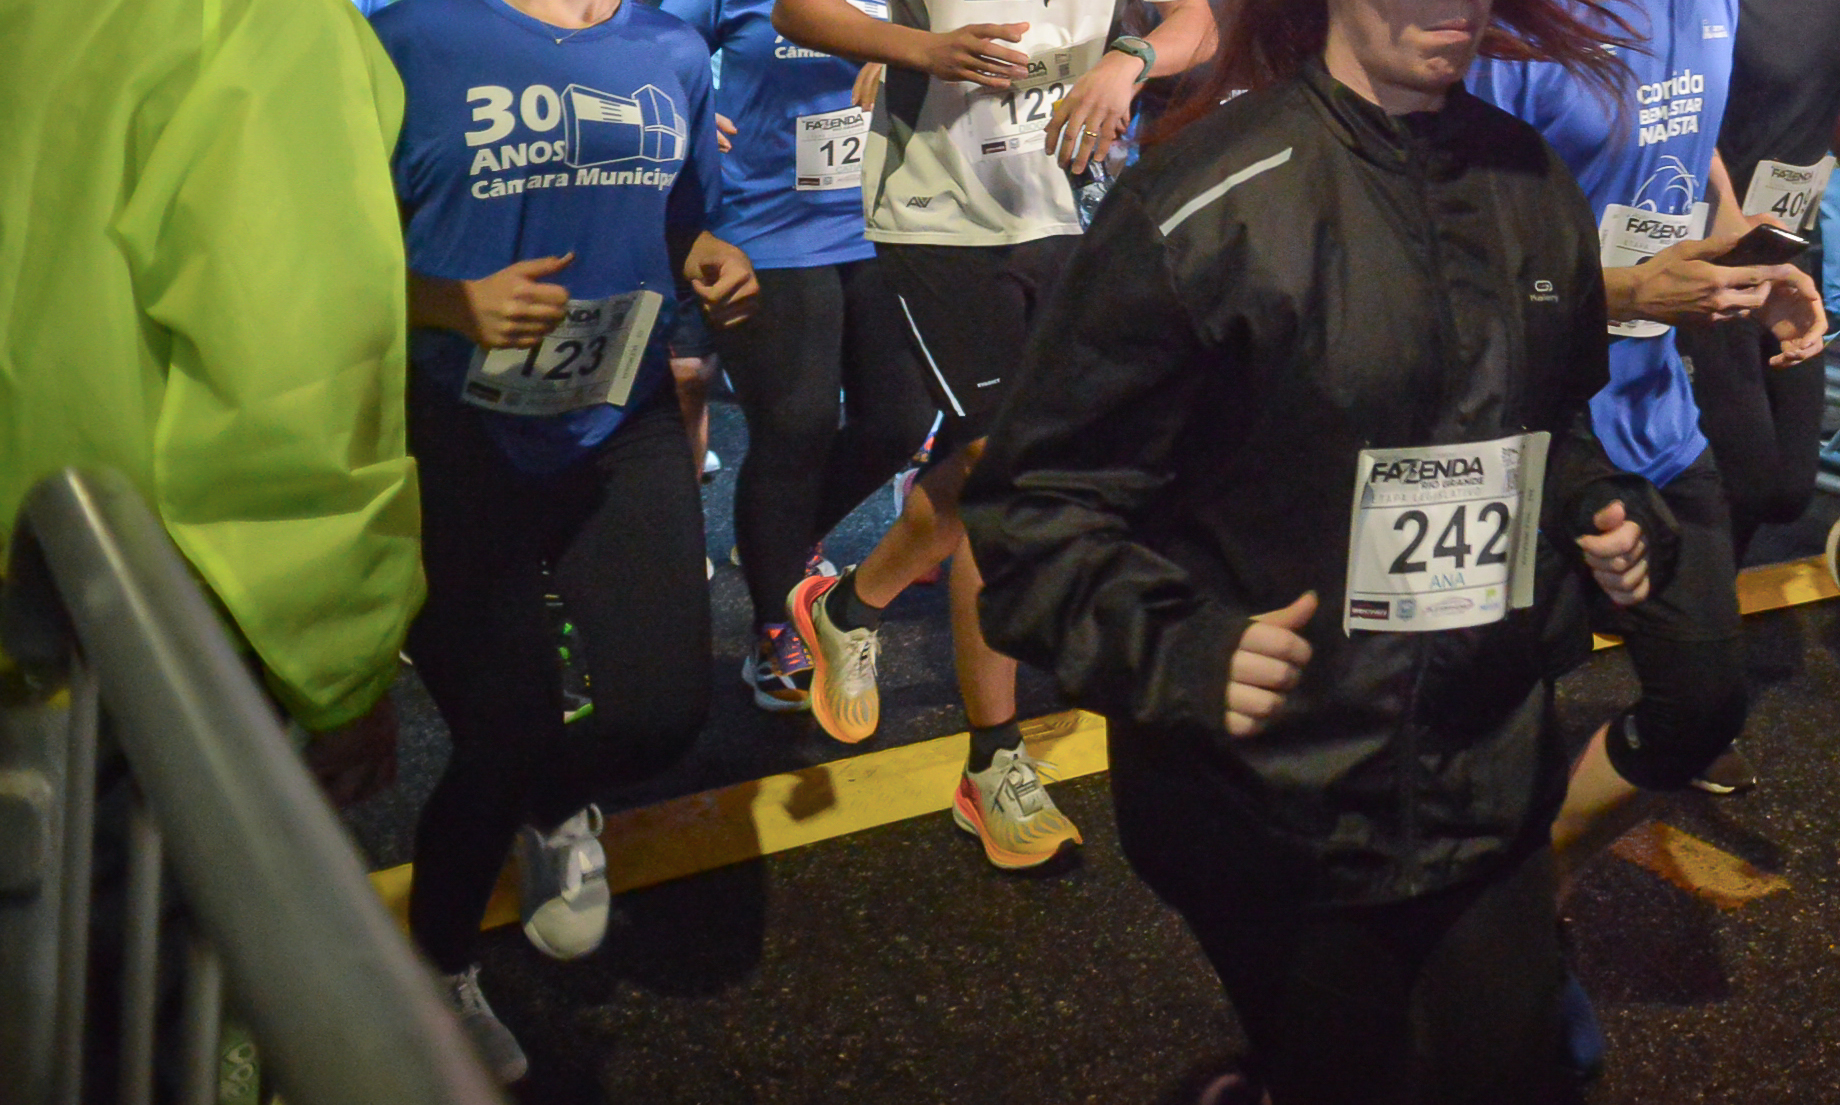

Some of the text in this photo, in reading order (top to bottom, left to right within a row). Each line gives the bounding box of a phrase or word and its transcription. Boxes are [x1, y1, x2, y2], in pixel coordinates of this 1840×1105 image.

[464, 84, 562, 147] 30
[806, 114, 864, 130] FAZENDA
[469, 139, 566, 176] ANOS
[471, 171, 569, 199] Câmara
[520, 337, 608, 381] 123
[1371, 457, 1484, 483] FAZENDA
[1388, 502, 1510, 575] 242
[1431, 572, 1466, 589] ANA
